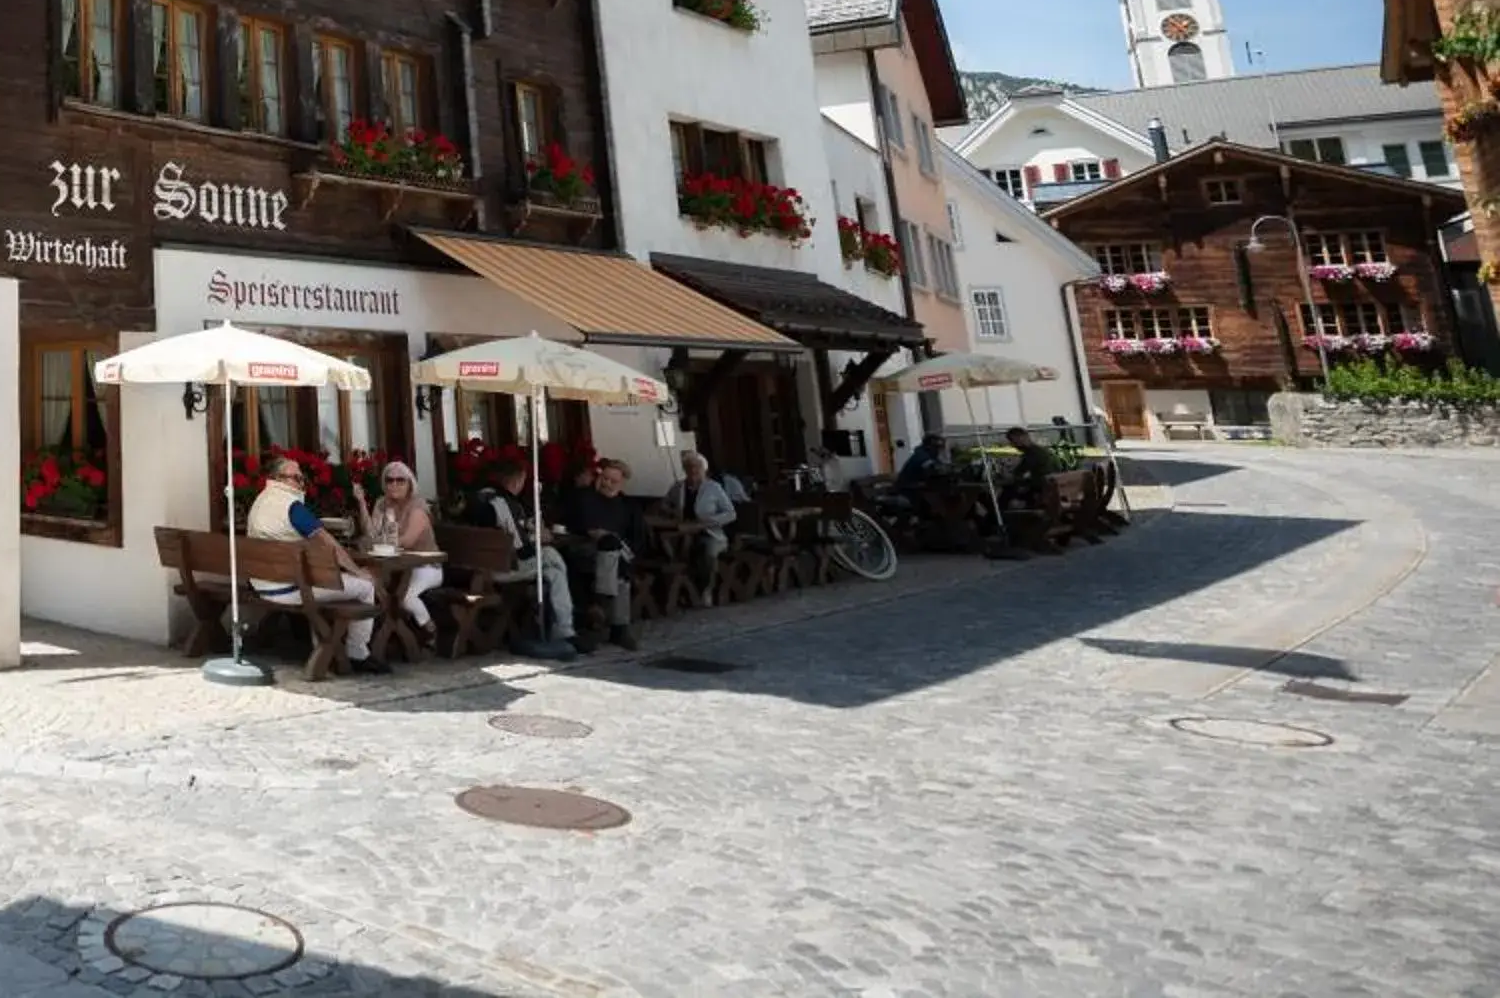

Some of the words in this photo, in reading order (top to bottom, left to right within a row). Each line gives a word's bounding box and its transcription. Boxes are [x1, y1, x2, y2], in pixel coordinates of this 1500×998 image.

[50, 160, 120, 217] zur
[153, 161, 289, 230] Sonne
[5, 229, 127, 272] Wirtschaft
[208, 269, 400, 315] Speiserestaurant
